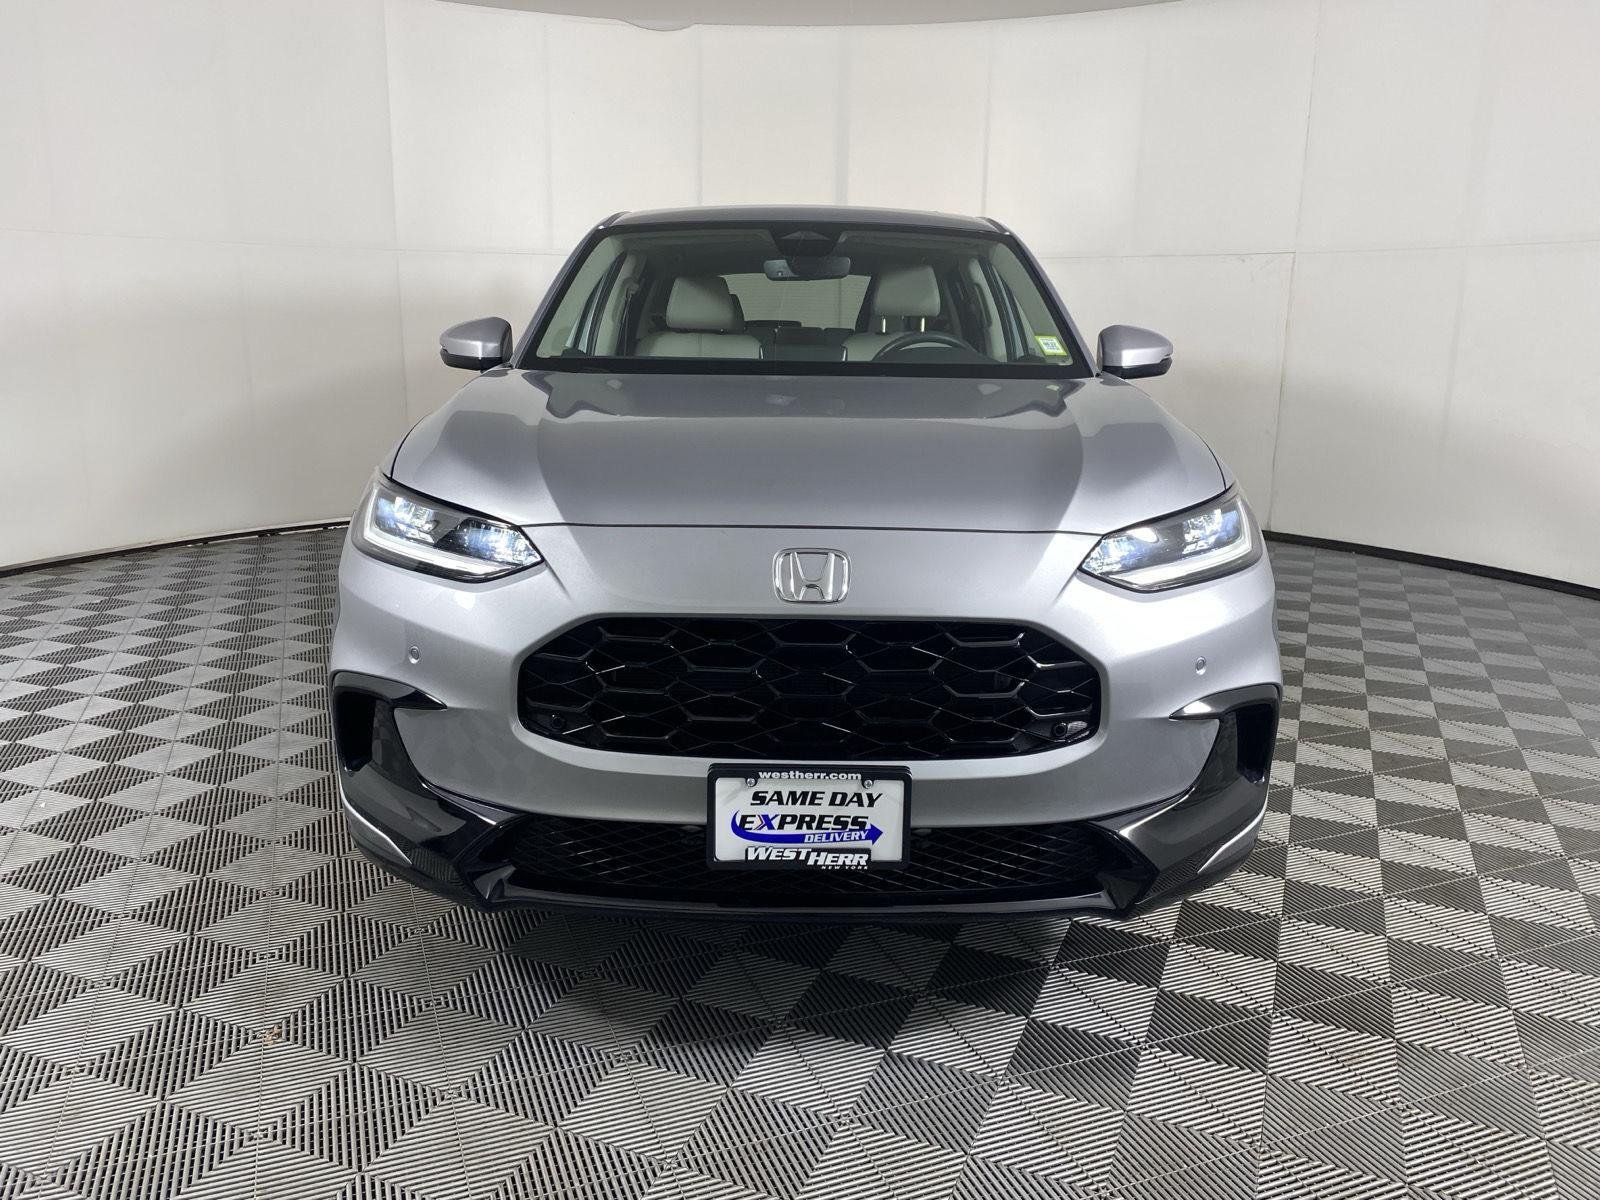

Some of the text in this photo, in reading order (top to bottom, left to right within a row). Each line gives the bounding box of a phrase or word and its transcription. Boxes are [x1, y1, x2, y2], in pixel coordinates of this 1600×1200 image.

[758, 771, 862, 780] westherr.com
[750, 791, 883, 808] SAME DAY
[738, 814, 869, 830] EXPRESS
[804, 831, 869, 843] DELIVERY
